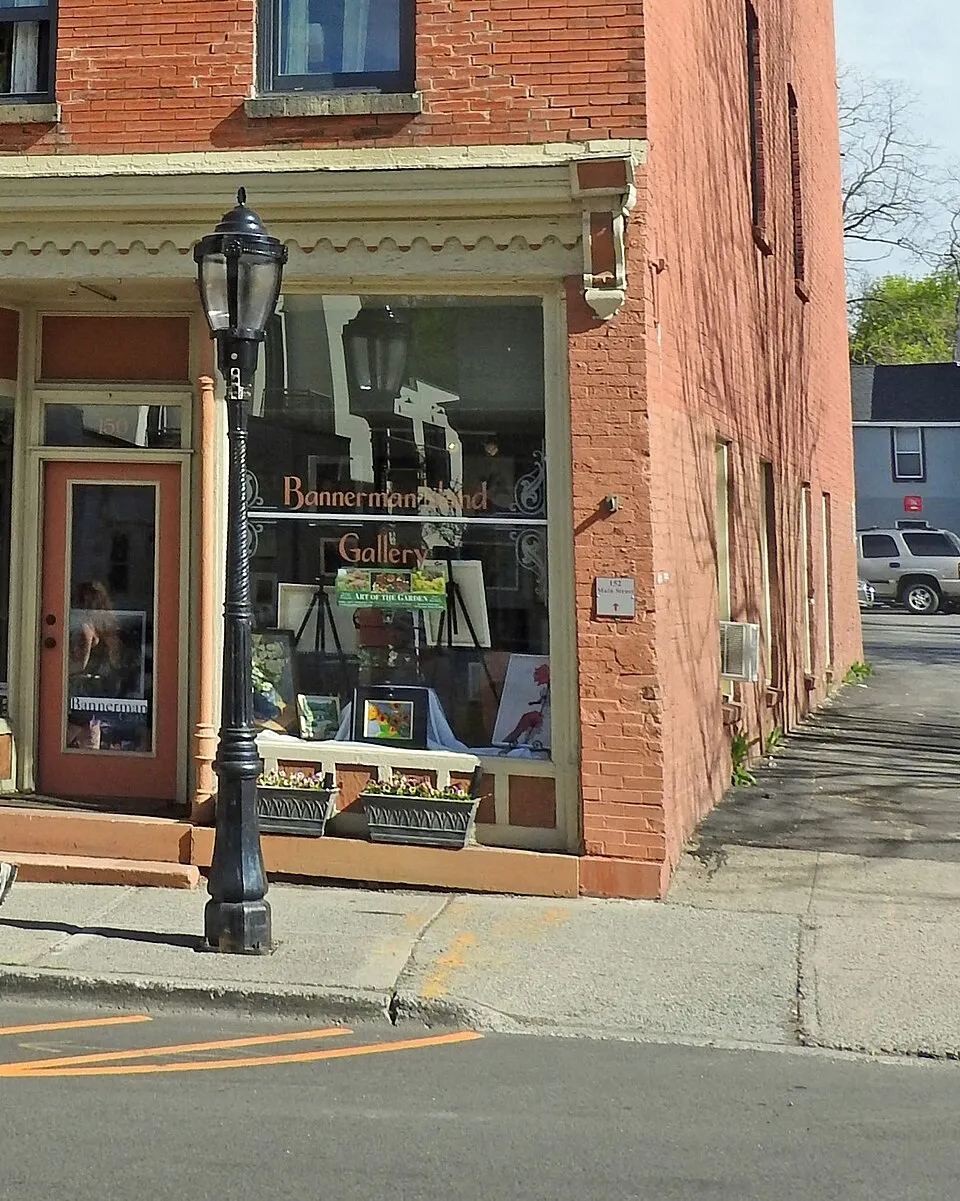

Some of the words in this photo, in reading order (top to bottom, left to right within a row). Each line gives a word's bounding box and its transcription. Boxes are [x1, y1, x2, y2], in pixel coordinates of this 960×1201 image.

[99, 417, 129, 435] 150
[283, 475, 417, 511] Bannerman
[339, 532, 428, 570] Gallery
[72, 696, 148, 714] Bannerman
